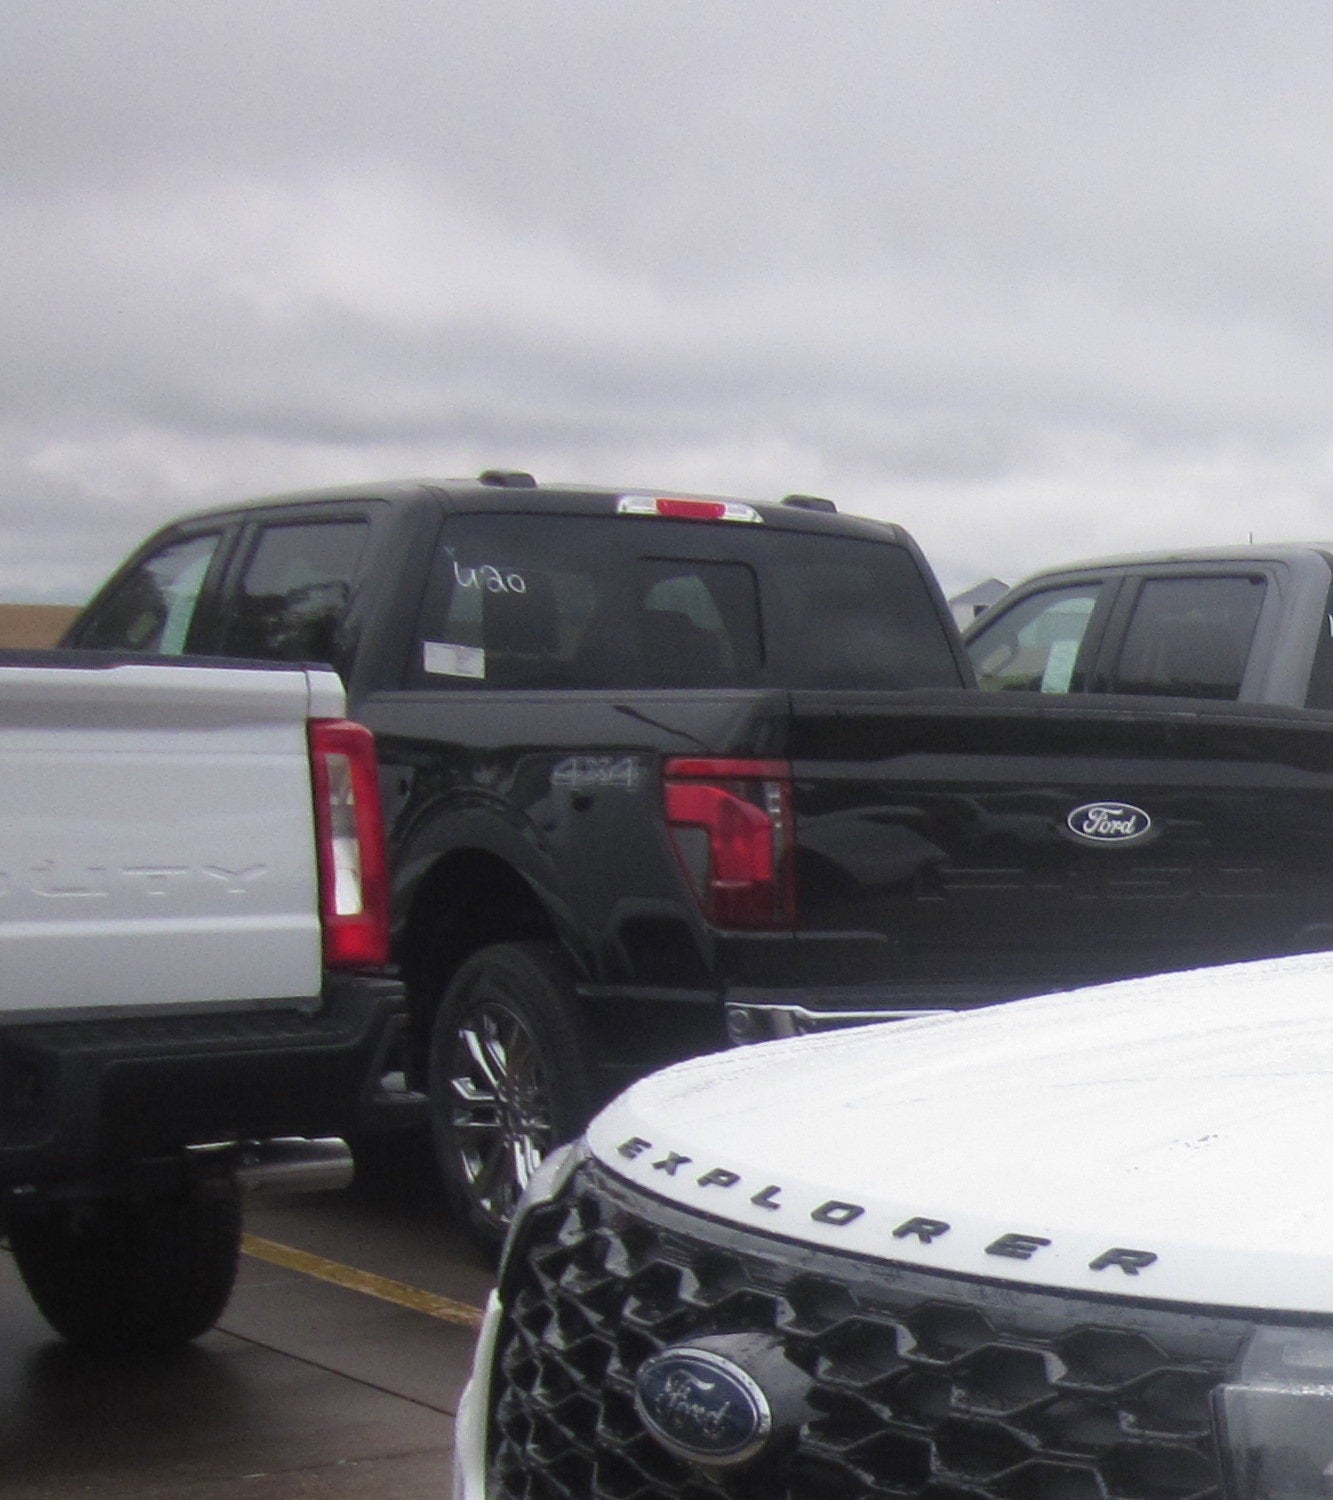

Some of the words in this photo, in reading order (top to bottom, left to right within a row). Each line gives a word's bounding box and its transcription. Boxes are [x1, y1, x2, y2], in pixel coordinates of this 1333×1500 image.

[1083, 807, 1137, 835] Ford
[0, 862, 267, 897] UTY
[617, 1136, 1158, 1276] EXPLORER
